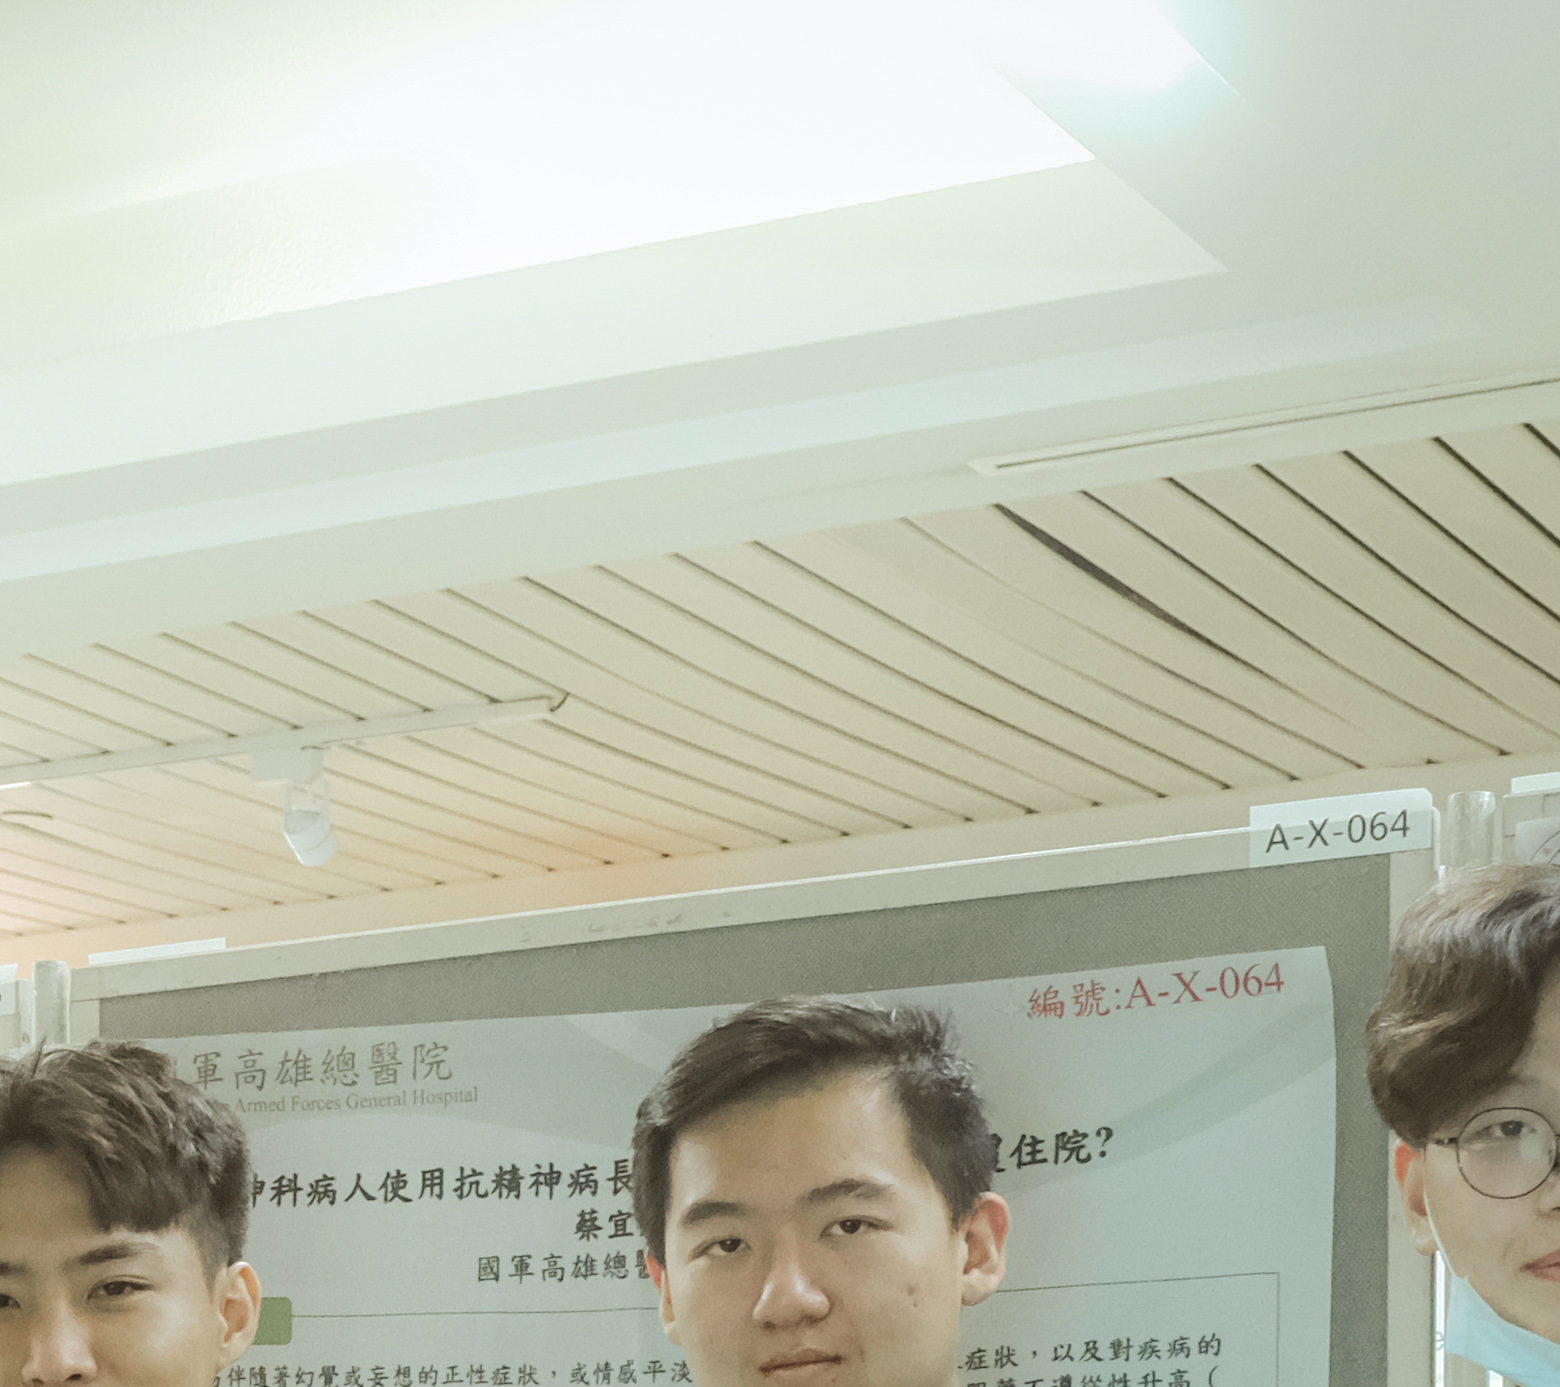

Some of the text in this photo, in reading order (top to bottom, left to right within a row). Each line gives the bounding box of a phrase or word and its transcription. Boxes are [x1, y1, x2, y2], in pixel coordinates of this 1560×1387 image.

[1265, 809, 1411, 854] A-X-064
[1027, 962, 1284, 1020] 編號:A-X-064
[235, 1085, 479, 1115] Armed Forces General Hospital
